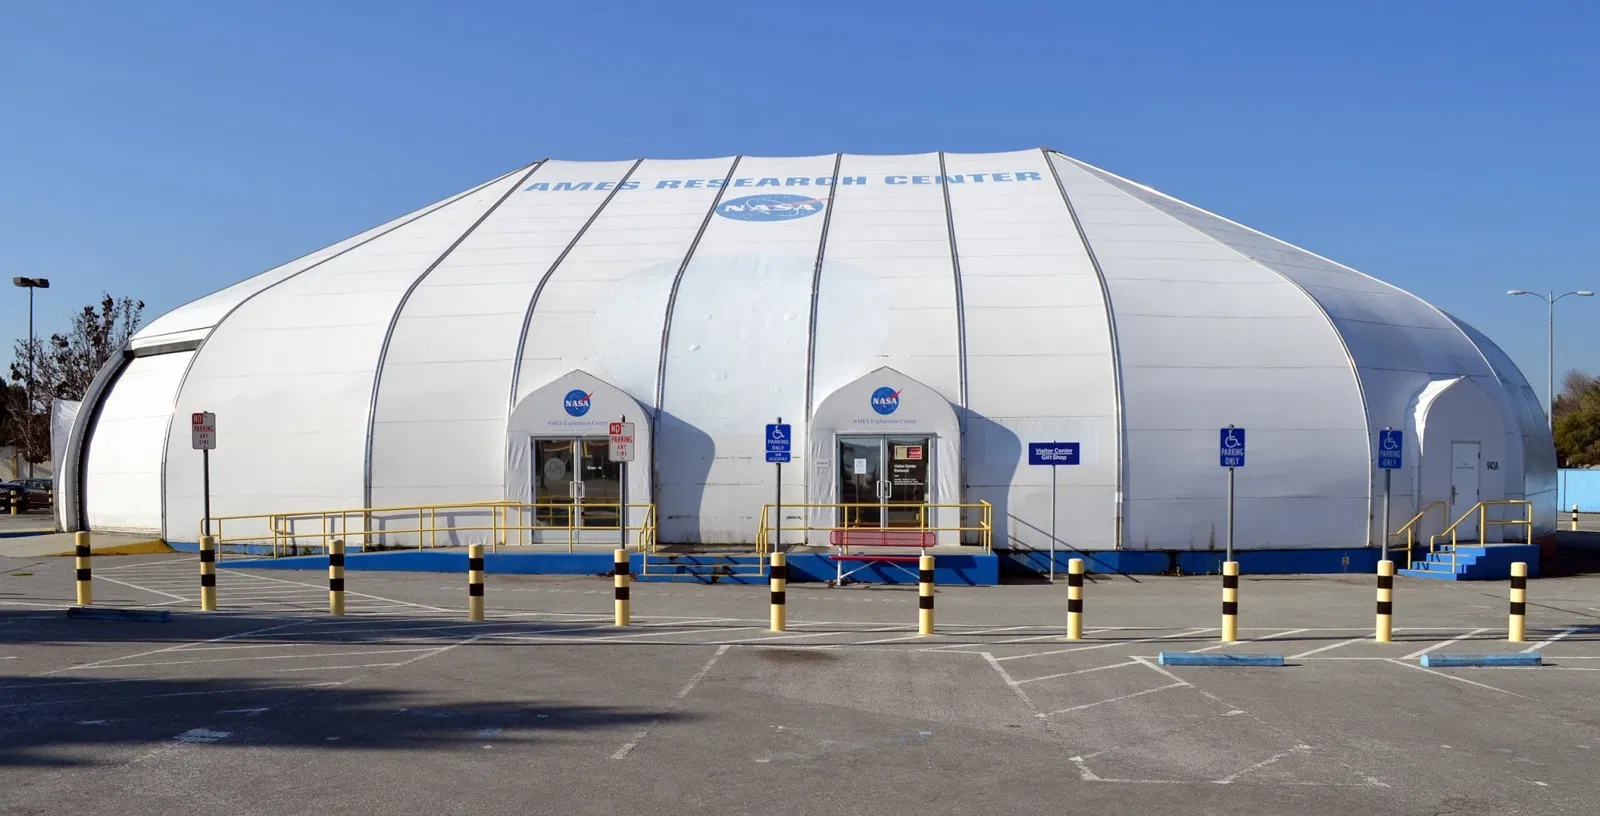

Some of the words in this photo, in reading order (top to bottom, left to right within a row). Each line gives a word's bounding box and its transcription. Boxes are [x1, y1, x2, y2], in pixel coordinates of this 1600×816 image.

[523, 181, 641, 192] AMES
[655, 176, 867, 189] RESEARCH
[884, 171, 1042, 185] CENTER
[725, 203, 817, 212] NASA
[194, 414, 202, 422] NO
[611, 424, 620, 433] NO
[1222, 448, 1244, 456] PARKING
[1380, 450, 1401, 458] PARKING
[1382, 458, 1397, 466] ONLY
[1486, 461, 1498, 470] 943A
